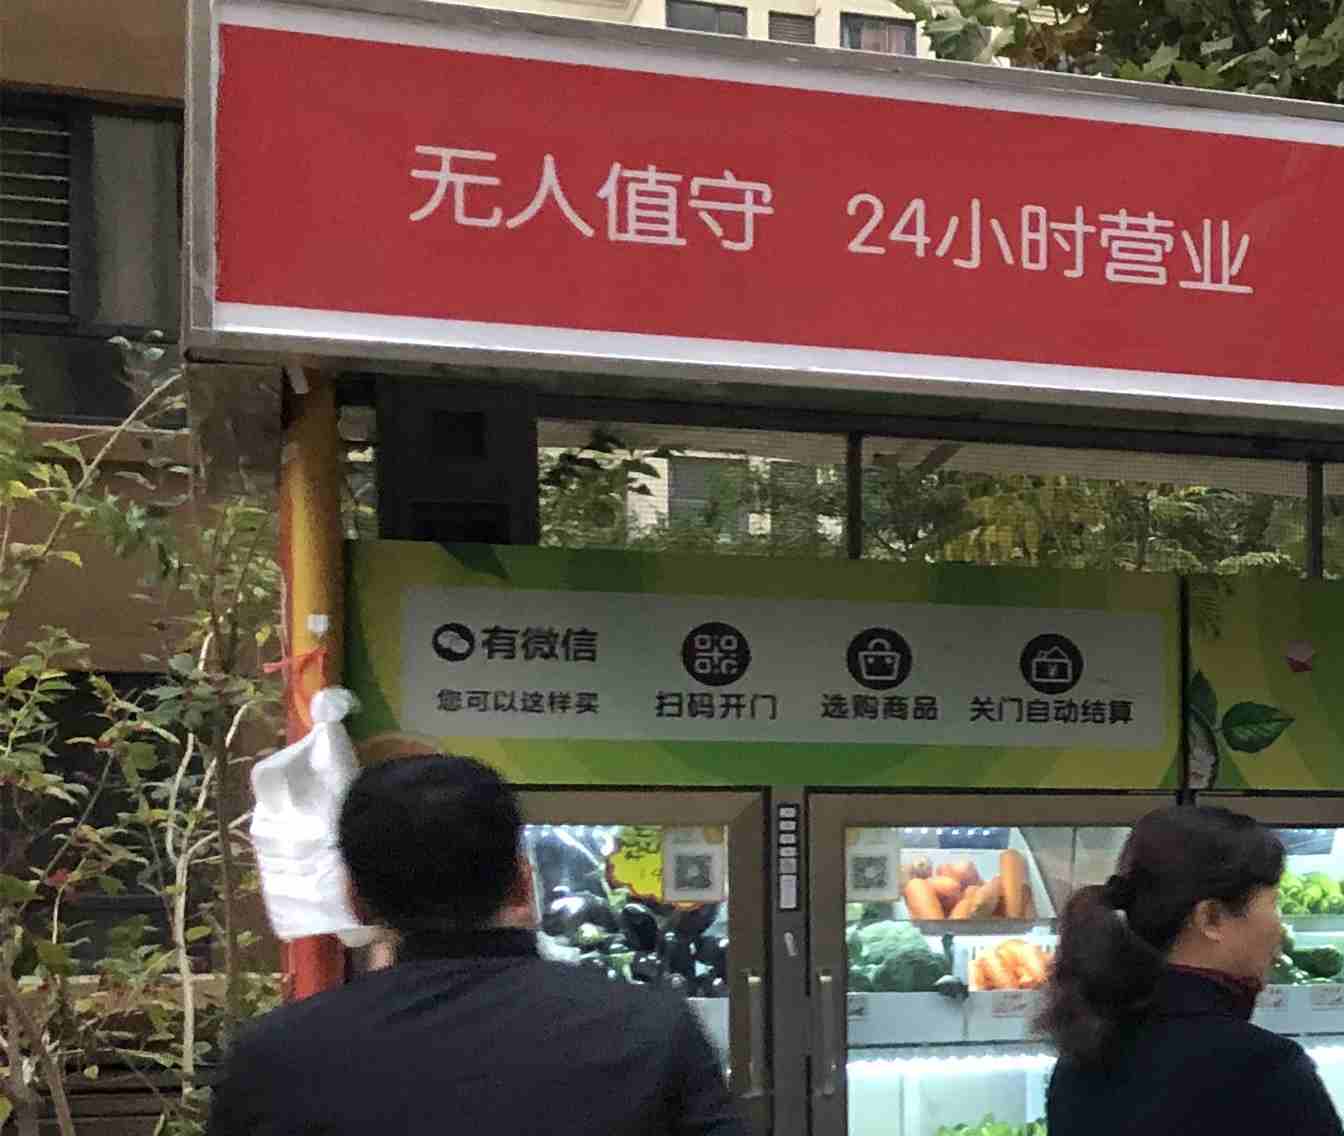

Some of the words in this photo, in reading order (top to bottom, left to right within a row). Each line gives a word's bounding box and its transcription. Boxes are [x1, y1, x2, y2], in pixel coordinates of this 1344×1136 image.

[409, 145, 774, 251] 无人值守
[847, 193, 1254, 294] 24小时营业
[481, 625, 598, 662] 有微信
[436, 689, 600, 714] 您可以这样买
[655, 691, 777, 720] 扫码开门
[821, 694, 939, 721] 选购商品
[969, 696, 1134, 725] 关门自动结算
